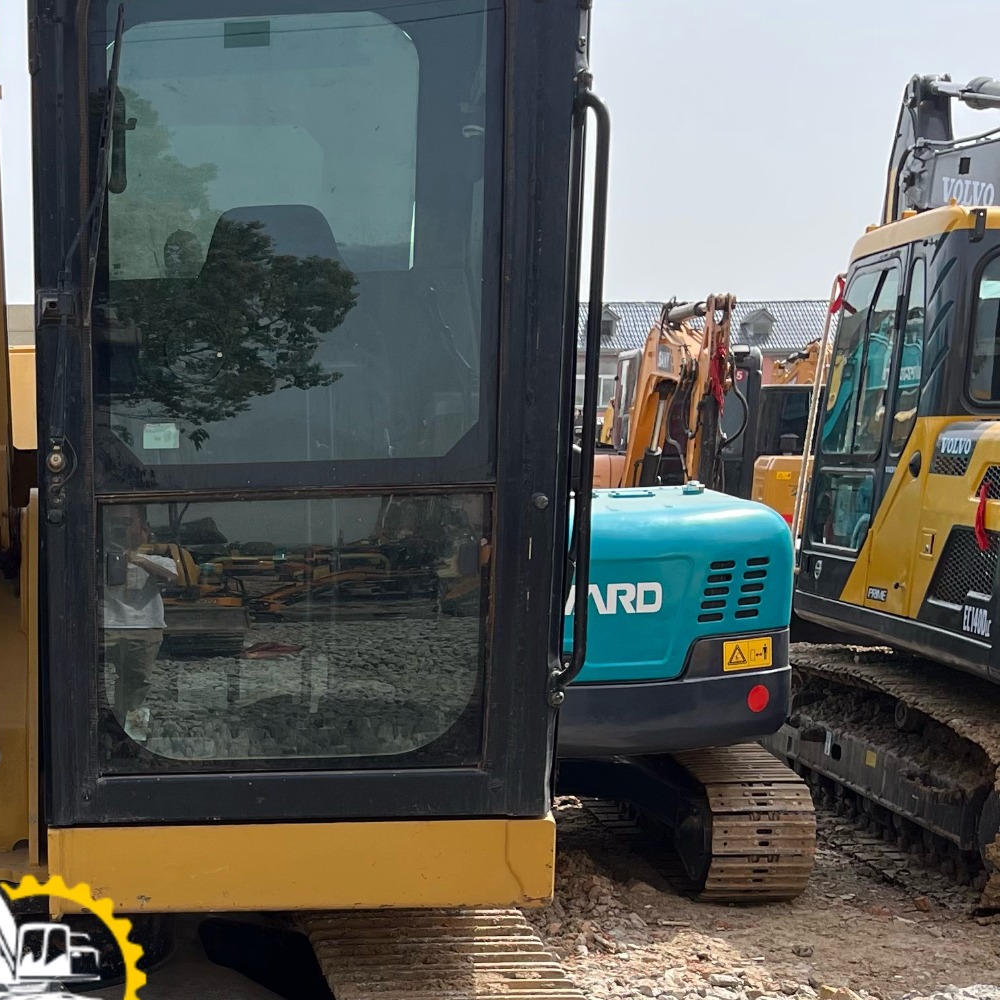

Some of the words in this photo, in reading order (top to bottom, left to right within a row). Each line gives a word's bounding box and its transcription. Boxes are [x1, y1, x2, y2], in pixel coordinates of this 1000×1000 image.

[942, 176, 995, 206] VOLVO
[940, 438, 971, 455] VOLVO
[868, 587, 887, 601] PRIME
